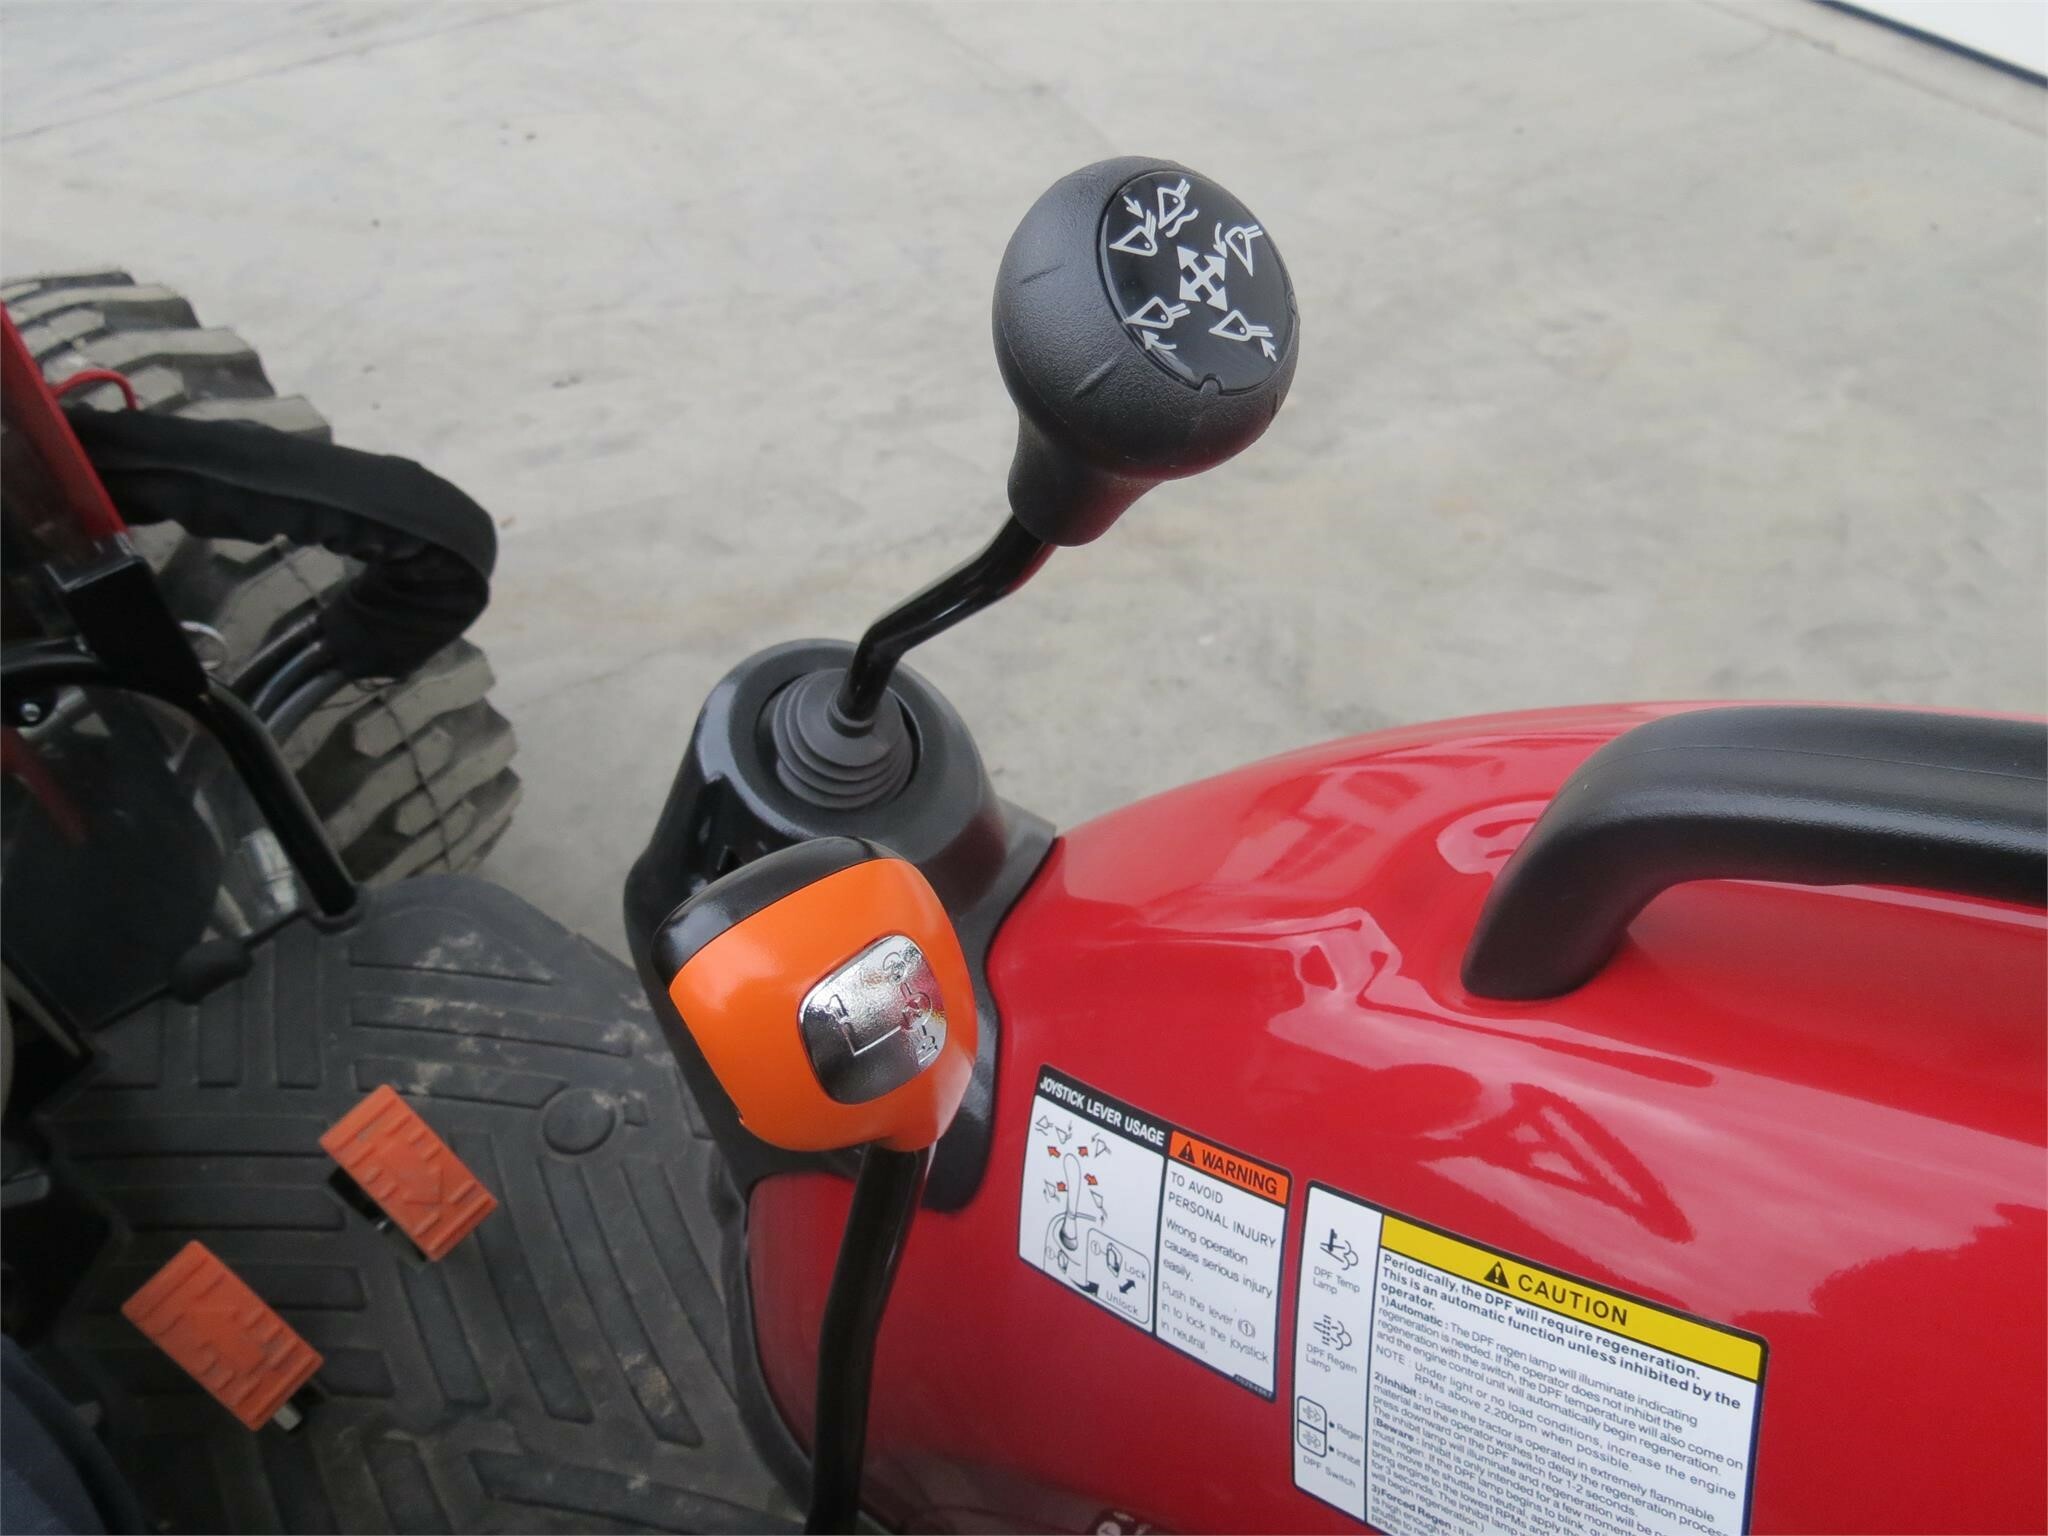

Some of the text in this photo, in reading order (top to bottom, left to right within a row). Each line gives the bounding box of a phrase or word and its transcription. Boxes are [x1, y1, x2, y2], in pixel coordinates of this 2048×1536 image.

[1040, 1076, 1165, 1147] JOYSTICK LEVER USAGE
[1170, 1171, 1224, 1205] TO AVOID
[1202, 1151, 1278, 1196] WARNING
[1165, 1218, 1249, 1265] Wrong operation
[1168, 1193, 1277, 1249] PERSONAL INJURY
[1124, 1261, 1146, 1280] Lock
[1164, 1239, 1272, 1299] causes serious injury
[1313, 1265, 1360, 1293] DPF Temp
[1313, 1277, 1338, 1295] Lamp
[1380, 1282, 1435, 1310] operator.
[1106, 1290, 1138, 1316] Unlock
[1161, 1281, 1186, 1303] Push
[1189, 1295, 1205, 1312] the
[1209, 1305, 1233, 1325] lever
[1161, 1320, 1170, 1332] in
[1383, 1254, 1700, 1380] Periodically, the DPF will require regeneration.
[1518, 1274, 1628, 1327] CAUTION
[1161, 1302, 1269, 1364] in to lock the joystick
[1306, 1343, 1358, 1374] DPF Regen
[1380, 1293, 1698, 1429] 1)Automatic The DPF regen lamp will illuminate indicating
[1382, 1267, 1741, 1410] This is an automatic function unless inhibited by the
[1306, 1354, 1331, 1373] Lamp
[1376, 1330, 1395, 1345] and
[1395, 1335, 1412, 1352] the
[1412, 1345, 1448, 1366] engine
[1447, 1359, 1485, 1382] control
[1484, 1375, 1506, 1390] unit
[1506, 1384, 1525, 1398] will
[1525, 1391, 1602, 1432] automatically
[1601, 1419, 1638, 1443] begin
[1378, 1307, 1440, 1339] regeneration
[1440, 1330, 1450, 1343] is
[1494, 1352, 1503, 1365] If
[1502, 1355, 1521, 1372] the
[1520, 1364, 1570, 1391] operator
[1569, 1381, 1601, 1403] does
[1601, 1396, 1623, 1412] not
[1622, 1401, 1662, 1427] inhibit
[1661, 1416, 1683, 1435] the
[1375, 1343, 1406, 1365] NOTE
[1413, 1359, 1447, 1382] Under
[1448, 1374, 1474, 1394] light
[1475, 1387, 1488, 1400] or
[1489, 1393, 1507, 1407] no
[1507, 1398, 1534, 1419] load
[1605, 1438, 1662, 1471] increase
[1664, 1462, 1687, 1481] the
[1688, 1474, 1736, 1500] engine
[1377, 1318, 1439, 1351] regeneration
[1439, 1344, 1462, 1360] with
[1461, 1351, 1480, 1367] the
[1518, 1373, 1537, 1391] the
[1537, 1381, 1563, 1401] DPF
[1563, 1391, 1637, 1430] temperature
[1637, 1423, 1659, 1439] will
[1658, 1431, 1687, 1449] also
[1686, 1442, 1725, 1464] come
[1725, 1456, 1743, 1471] on
[1414, 1371, 1445, 1394] RPMs
[1447, 1388, 1481, 1409] above
[1540, 1427, 1573, 1448] when
[1303, 1455, 1356, 1488] DPF Switch
[1373, 1395, 1400, 1413] press
[1399, 1405, 1452, 1437] downward
[1452, 1431, 1467, 1443] on
[1467, 1435, 1485, 1451] the
[1485, 1443, 1510, 1462] DPF
[1510, 1456, 1547, 1478] switch
[1546, 1470, 1564, 1486] for
[1565, 1478, 1584, 1495] 1-2
[1373, 1384, 1411, 1407] material
[1412, 1401, 1432, 1416] and
[1431, 1408, 1449, 1424] the
[1449, 1418, 1494, 1444] operator
[1494, 1437, 1534, 1461] wishes
[1533, 1452, 1546, 1466] to
[1546, 1458, 1579, 1482] delay
[1578, 1471, 1599, 1489] the
[1599, 1482, 1678, 1522] regeneration
[1374, 1371, 1715, 1523] 2)Inhibit In case the tractor is operated in extremely flammable
